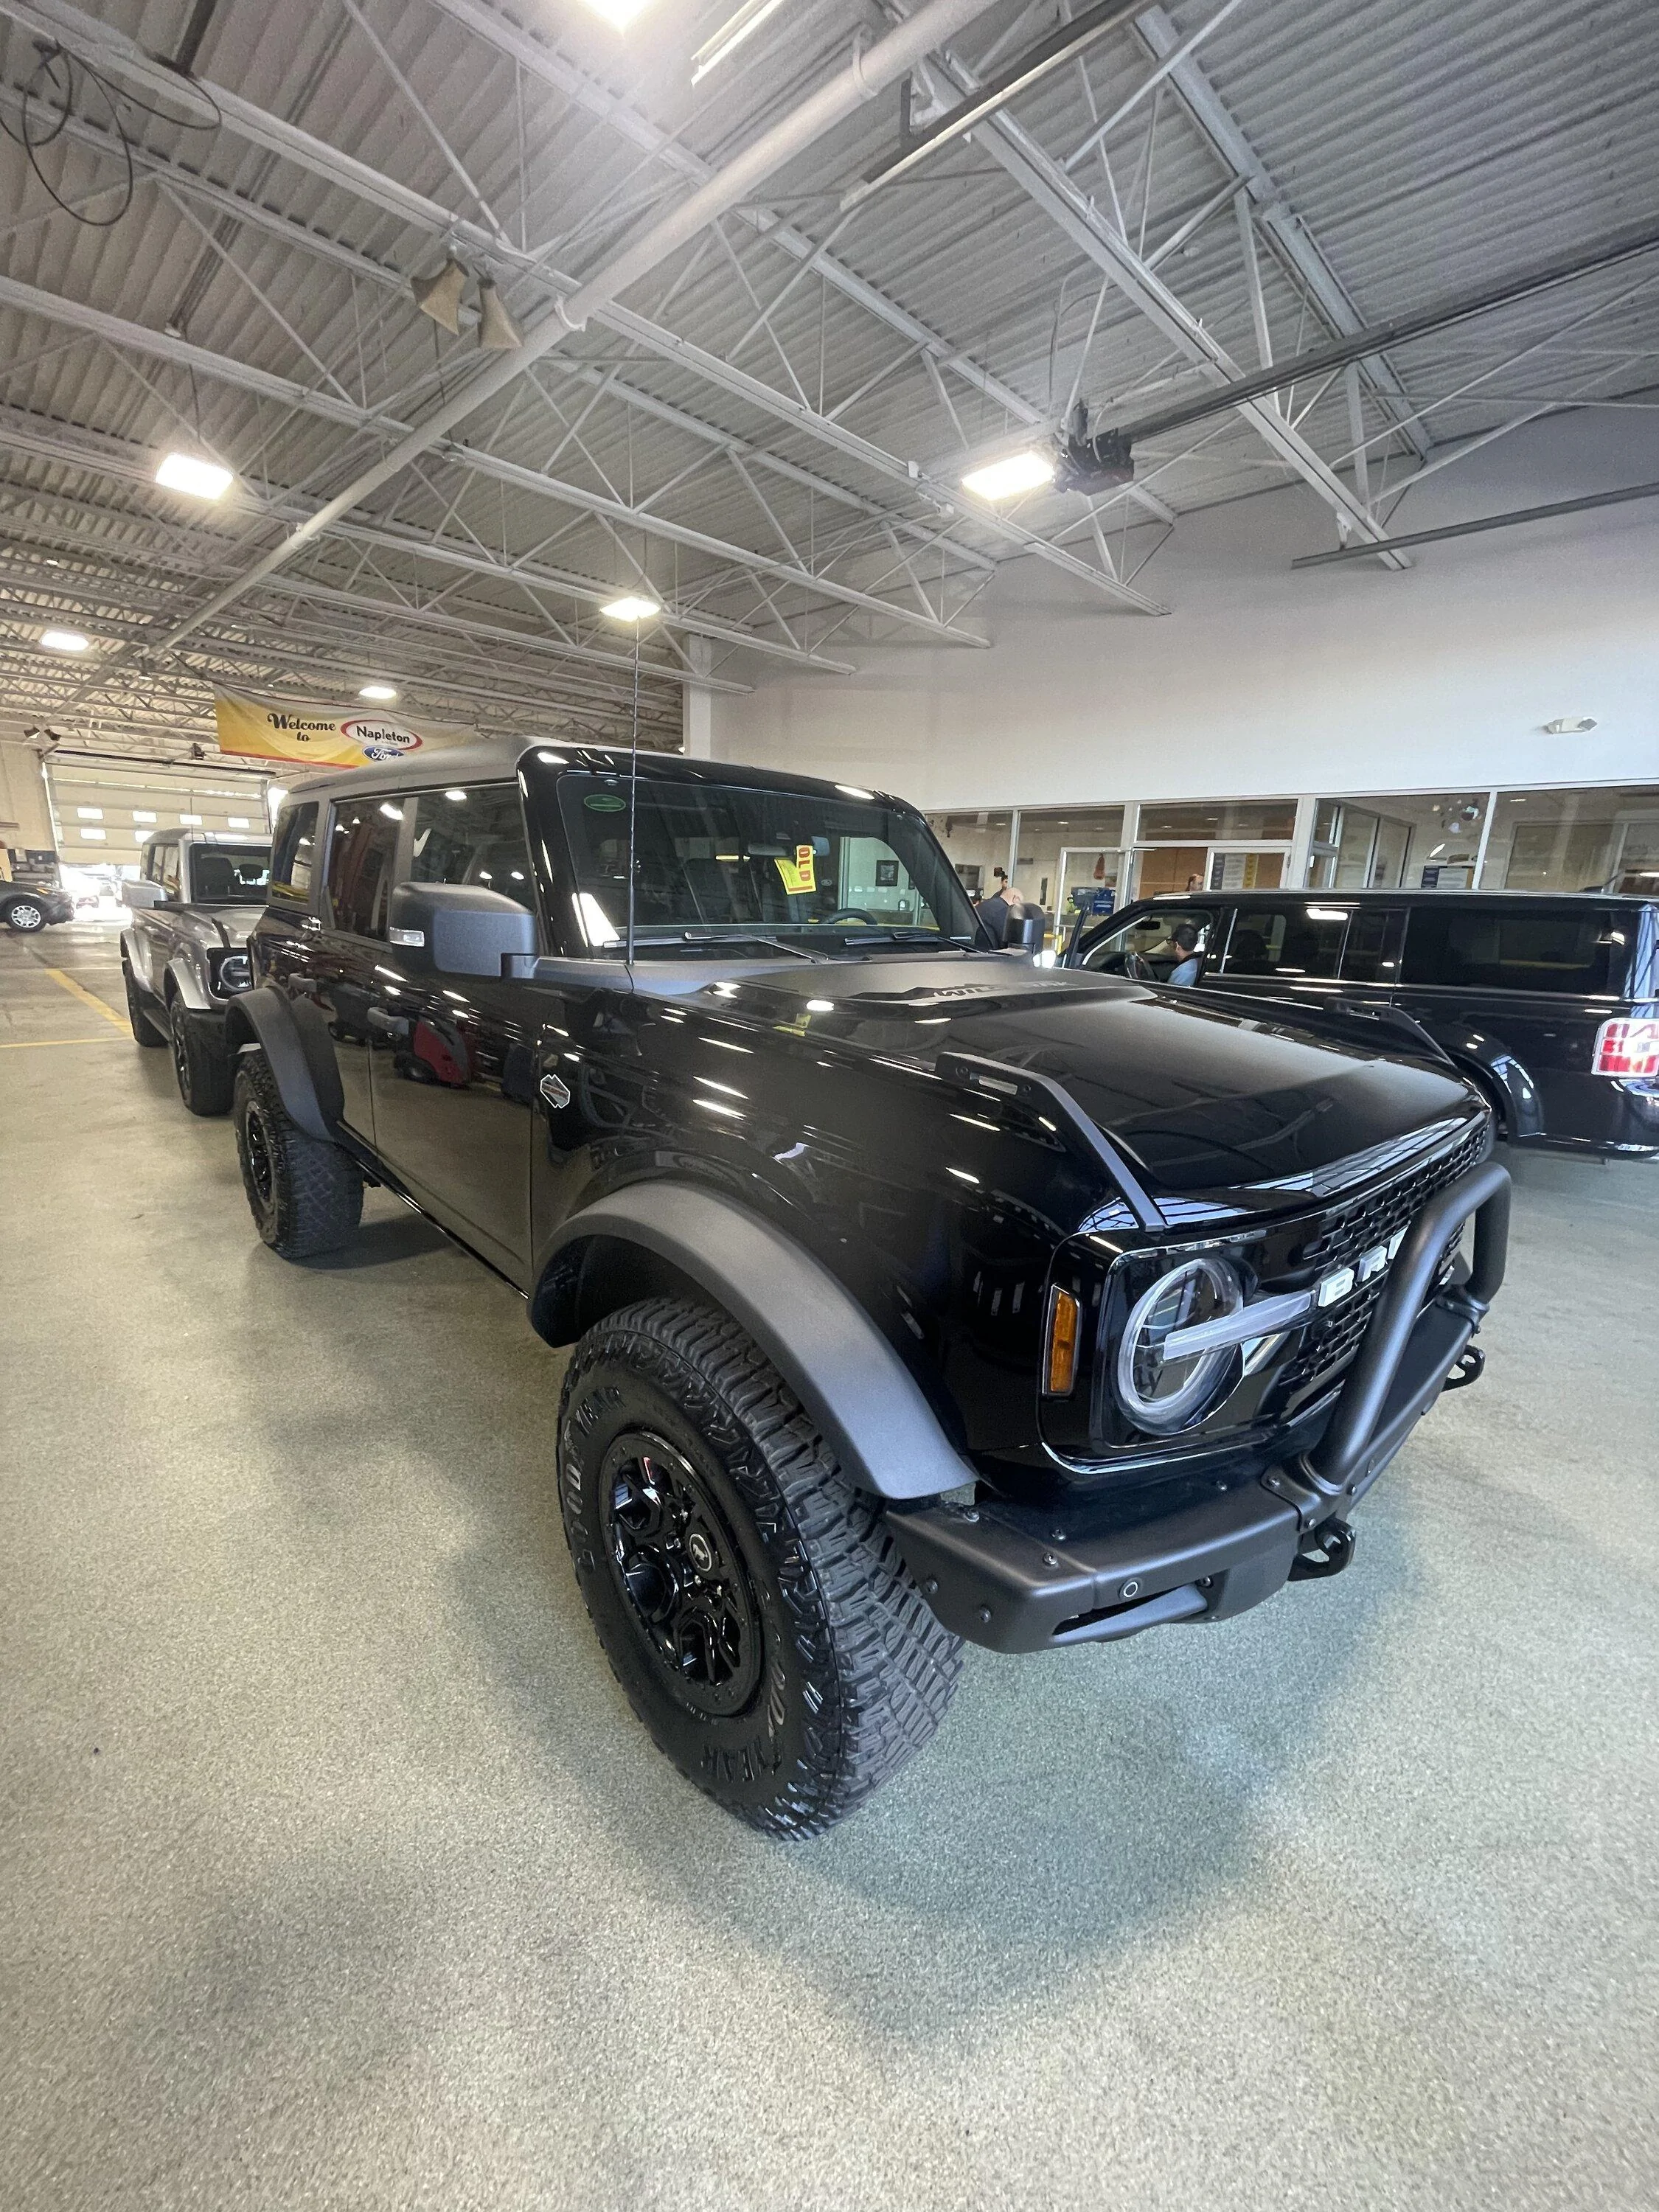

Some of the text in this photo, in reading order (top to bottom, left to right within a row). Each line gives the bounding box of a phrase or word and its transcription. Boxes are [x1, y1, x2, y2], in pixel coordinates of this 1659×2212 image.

[266, 713, 336, 731] Welcome
[296, 732, 311, 742] to
[356, 725, 411, 744] Napleton
